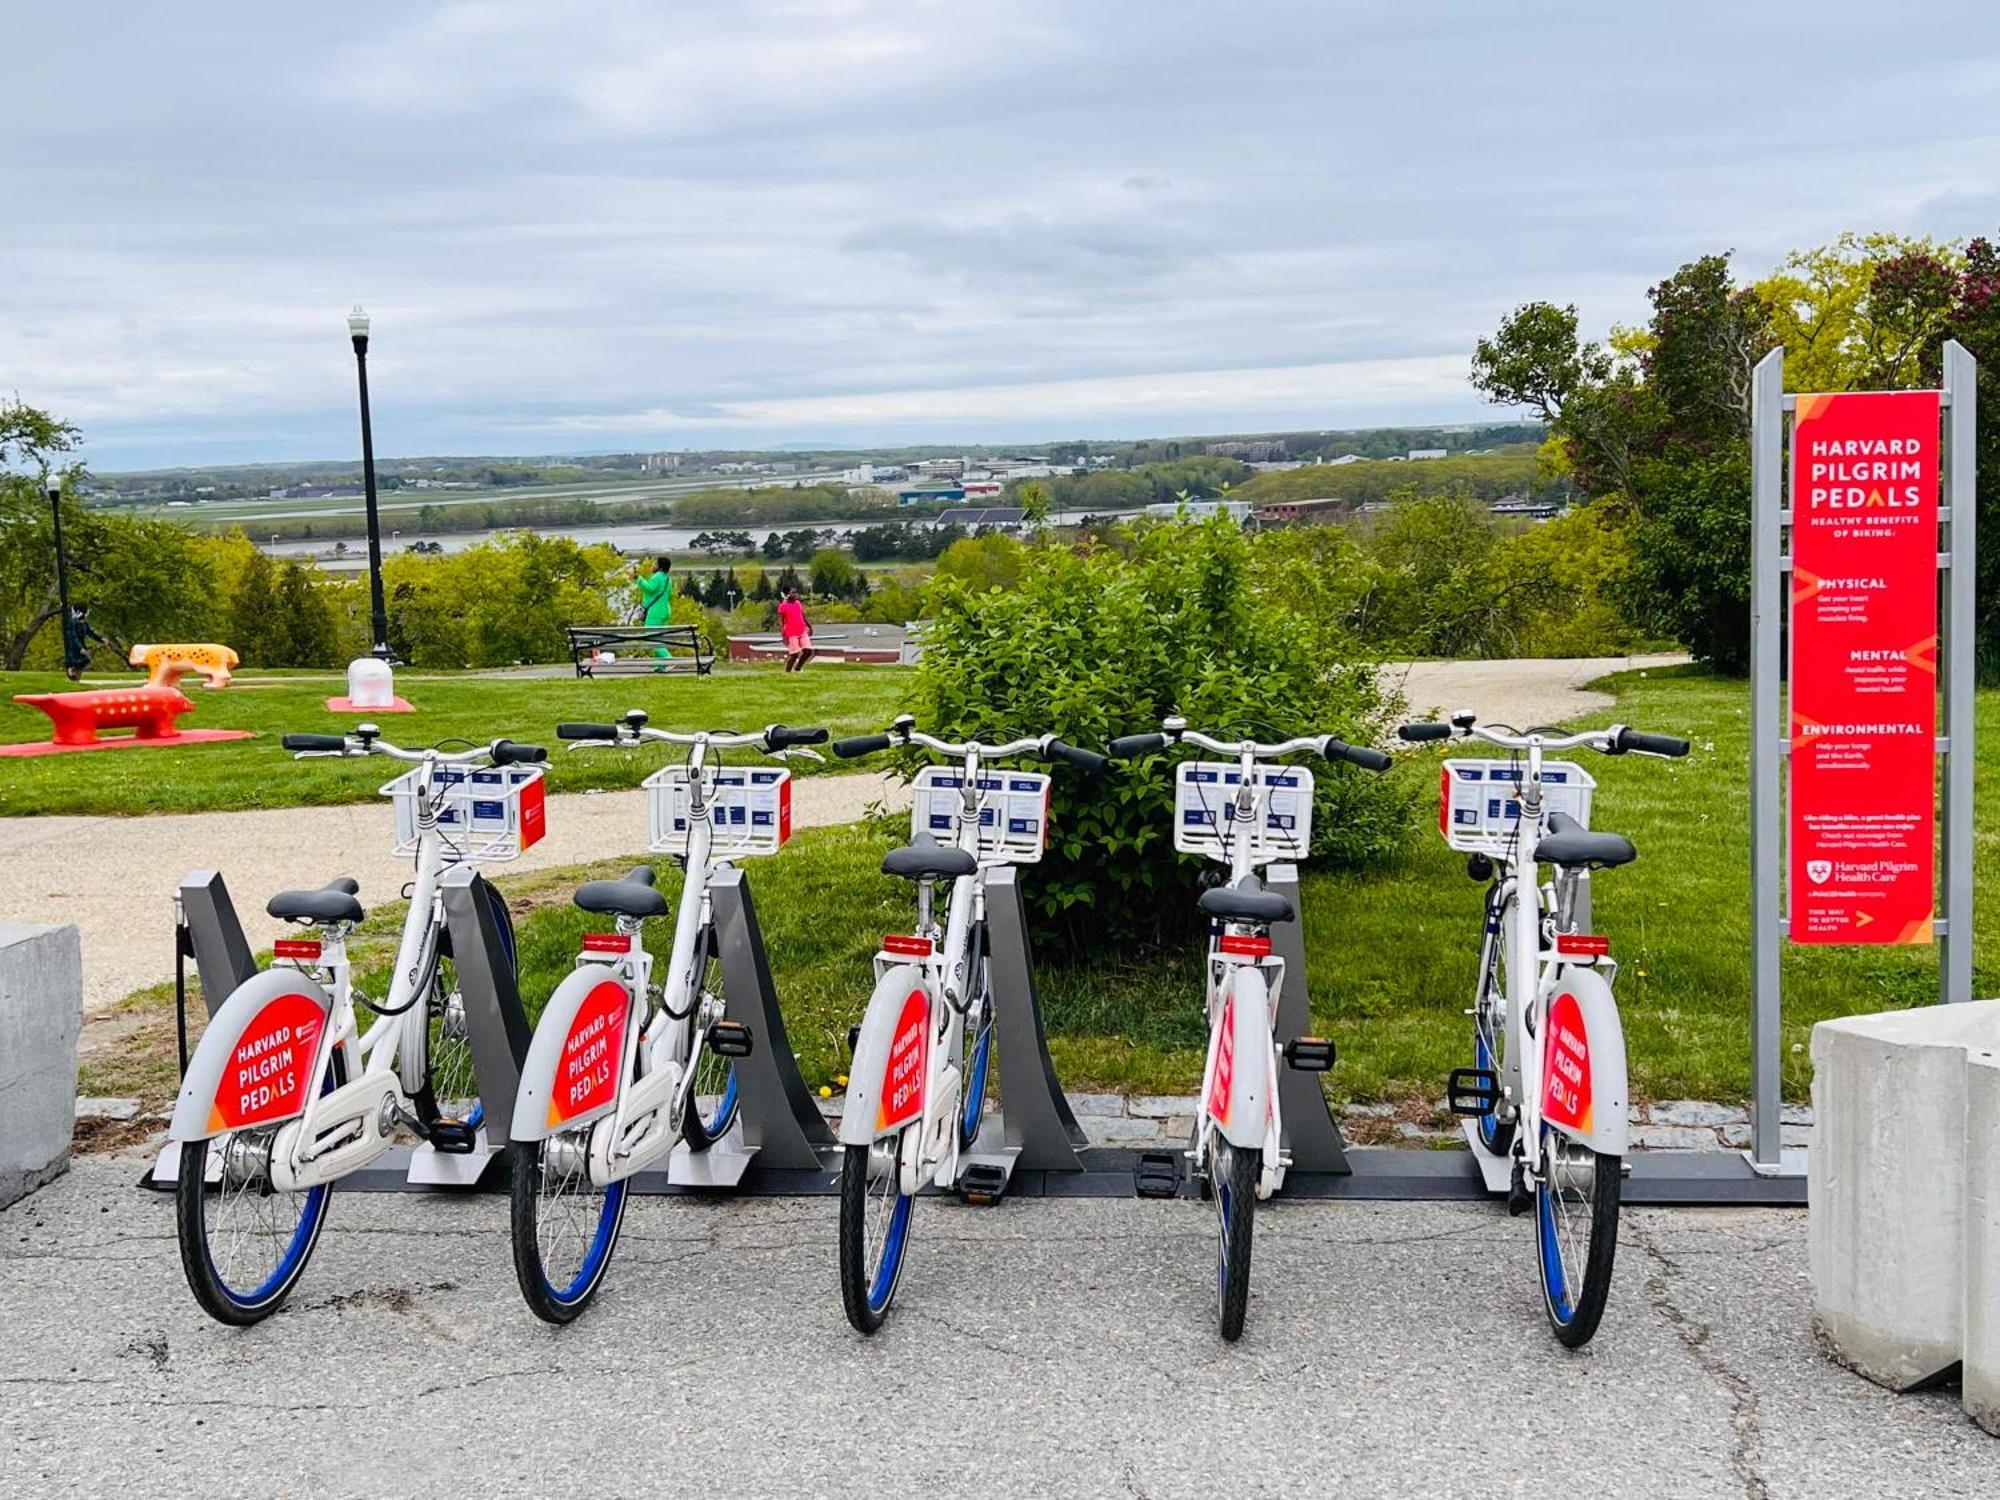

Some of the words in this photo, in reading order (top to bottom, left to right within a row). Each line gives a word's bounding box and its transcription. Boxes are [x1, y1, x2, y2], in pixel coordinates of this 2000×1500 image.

[1812, 440, 1920, 456] HARVARD
[1812, 462, 1920, 482] PILGRIM
[1811, 487, 1920, 509] PEDALS
[1811, 517, 1861, 526] HEALTHY
[1866, 516, 1919, 524] BENEFITS
[1834, 530, 1848, 538] OF
[1817, 578, 1887, 589] PHYSICAL
[1850, 650, 1908, 660] MENTAL
[1802, 724, 1923, 735] ENVIRONMENTAL
[1835, 862, 1878, 871] Harvard
[1880, 861, 1918, 873] Pilgrim
[1835, 872, 1871, 882] Health
[1872, 872, 1897, 882] Care
[237, 1026, 290, 1063] HARVARD
[567, 1015, 604, 1055] HARVARD
[239, 1048, 293, 1089] PILGRIM
[568, 1036, 607, 1079] PILGRIM
[893, 1044, 919, 1080] PILGRIM
[1554, 1048, 1582, 1087] PILGRIM
[240, 1072, 295, 1115] PEDALS
[569, 1061, 609, 1106] PEDALS
[892, 1070, 921, 1112] PEDALS
[1548, 1074, 1578, 1116] PEDALS
